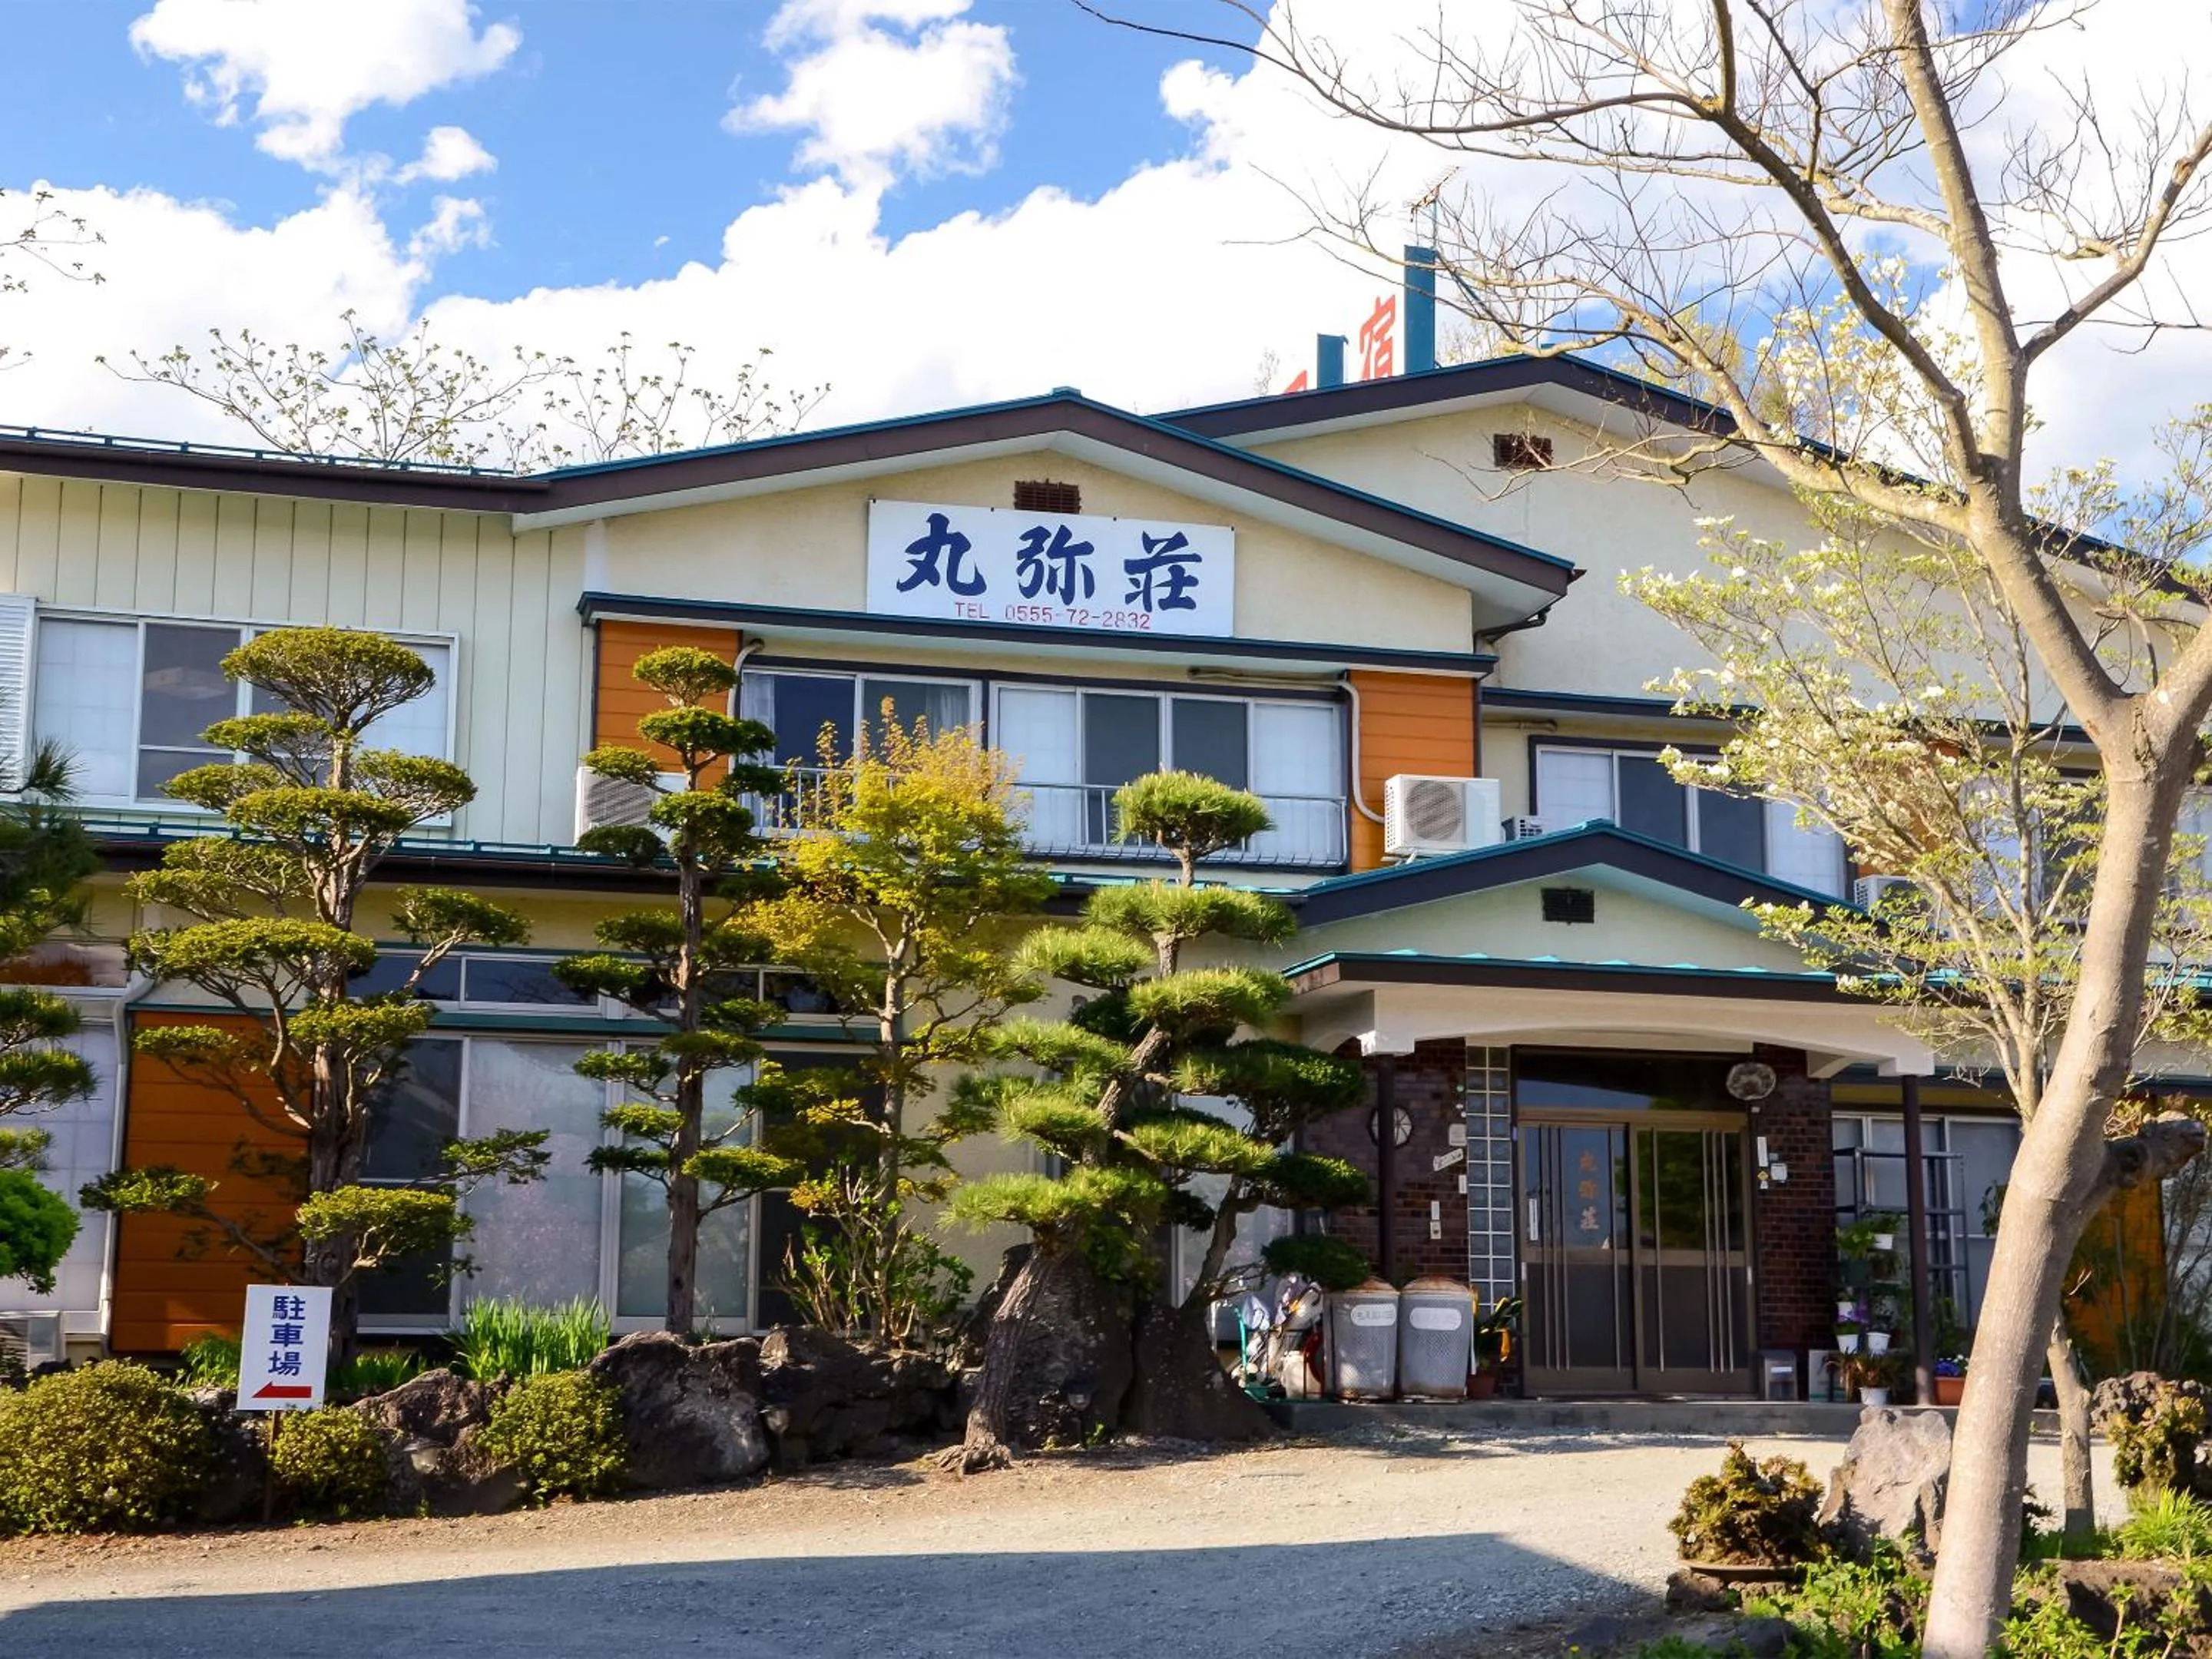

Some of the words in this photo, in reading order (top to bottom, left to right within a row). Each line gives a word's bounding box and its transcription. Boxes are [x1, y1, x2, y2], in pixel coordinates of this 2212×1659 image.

[897, 512, 1202, 612] 丸弥荘
[955, 602, 990, 619] TEL
[1005, 604, 1151, 630] 0555-72-2832
[268, 1295, 306, 1376] 駐車場
